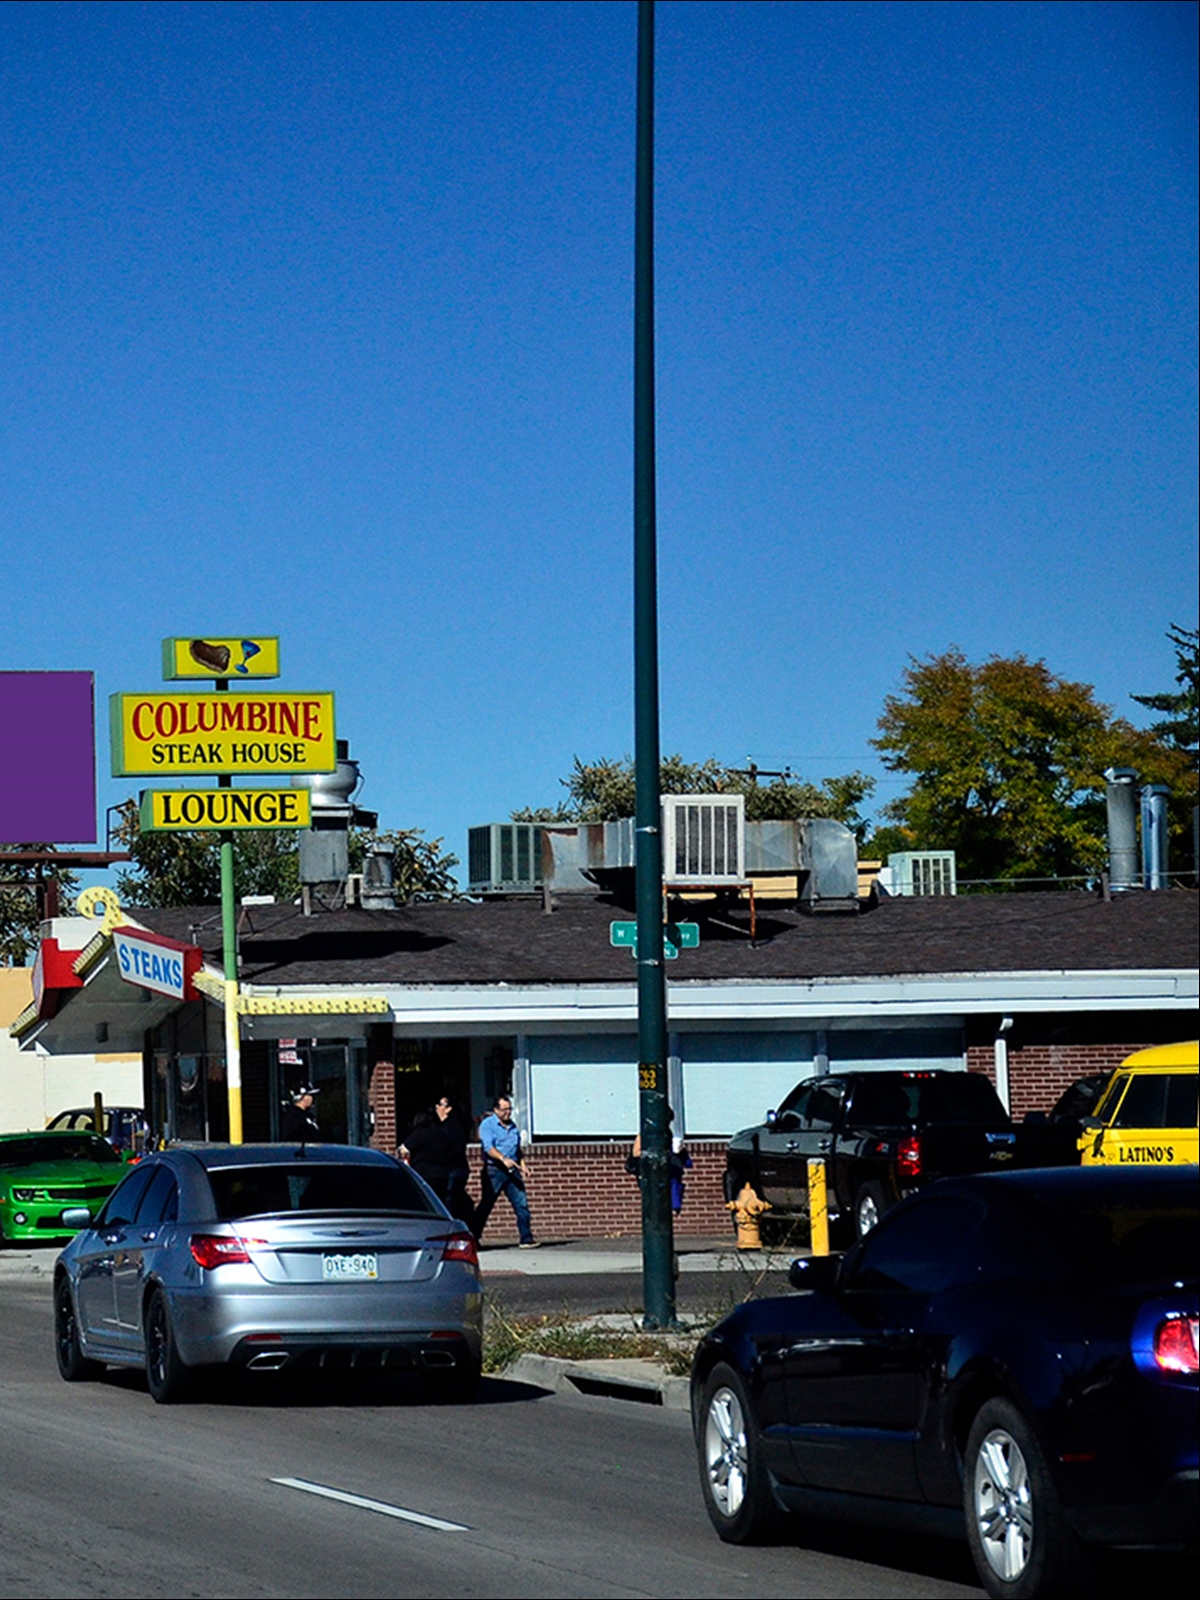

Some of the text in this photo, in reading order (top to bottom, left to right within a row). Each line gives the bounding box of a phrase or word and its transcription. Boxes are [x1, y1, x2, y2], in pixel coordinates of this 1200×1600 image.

[131, 701, 324, 743] COLUMBINE
[151, 743, 307, 765] STEAK HOUSE
[161, 793, 299, 824] LOUNGE
[119, 943, 184, 989] STEAKS
[1119, 1146, 1174, 1162] LATINO'S
